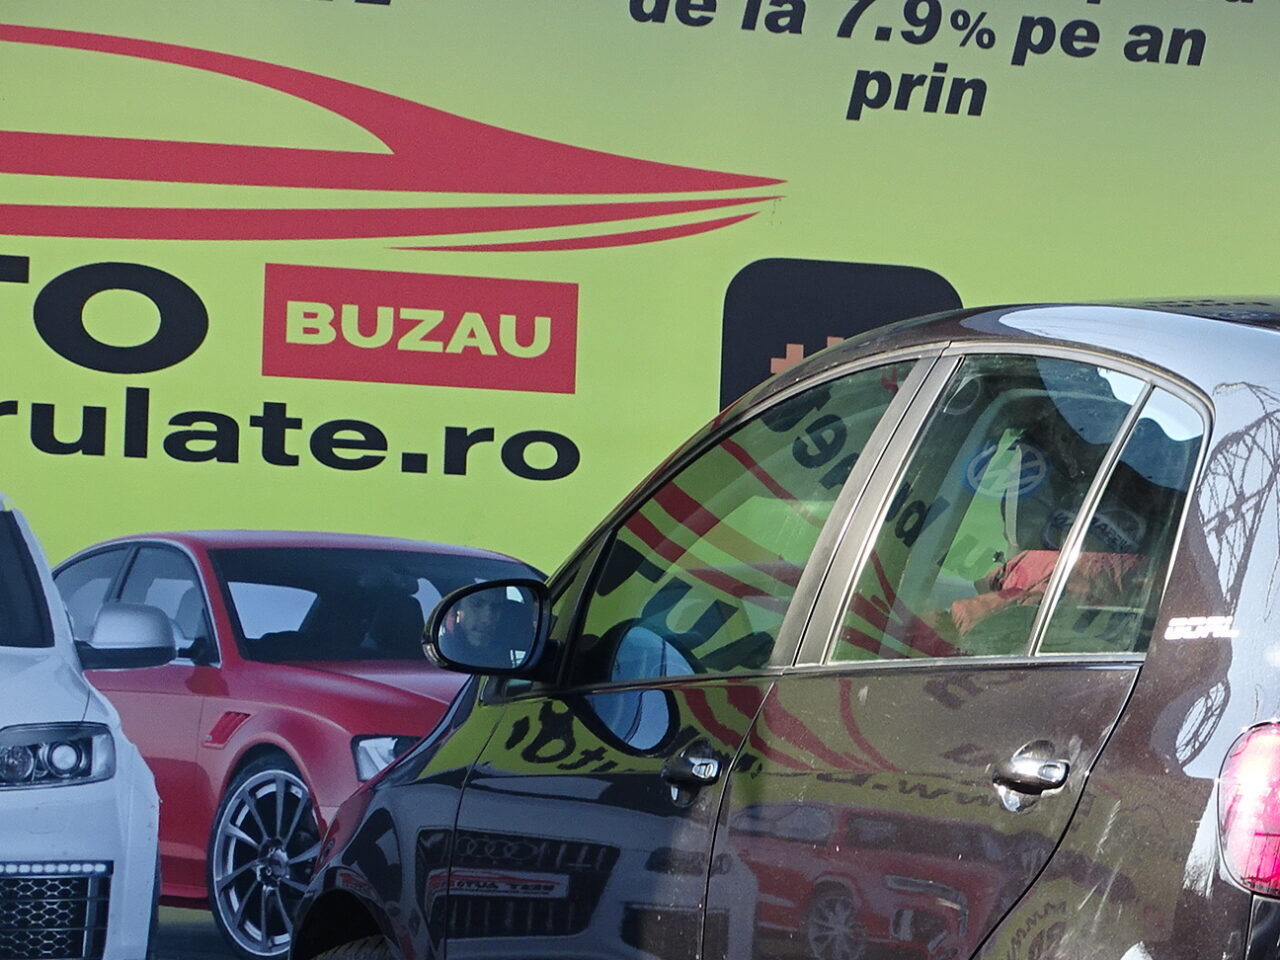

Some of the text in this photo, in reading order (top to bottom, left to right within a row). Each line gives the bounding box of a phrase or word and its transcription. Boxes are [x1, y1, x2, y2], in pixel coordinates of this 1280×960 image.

[1011, 16, 1100, 66] pe
[1123, 24, 1206, 66] an
[846, 62, 988, 121] prin
[0, 253, 210, 374] O
[285, 300, 552, 359] BUZAU
